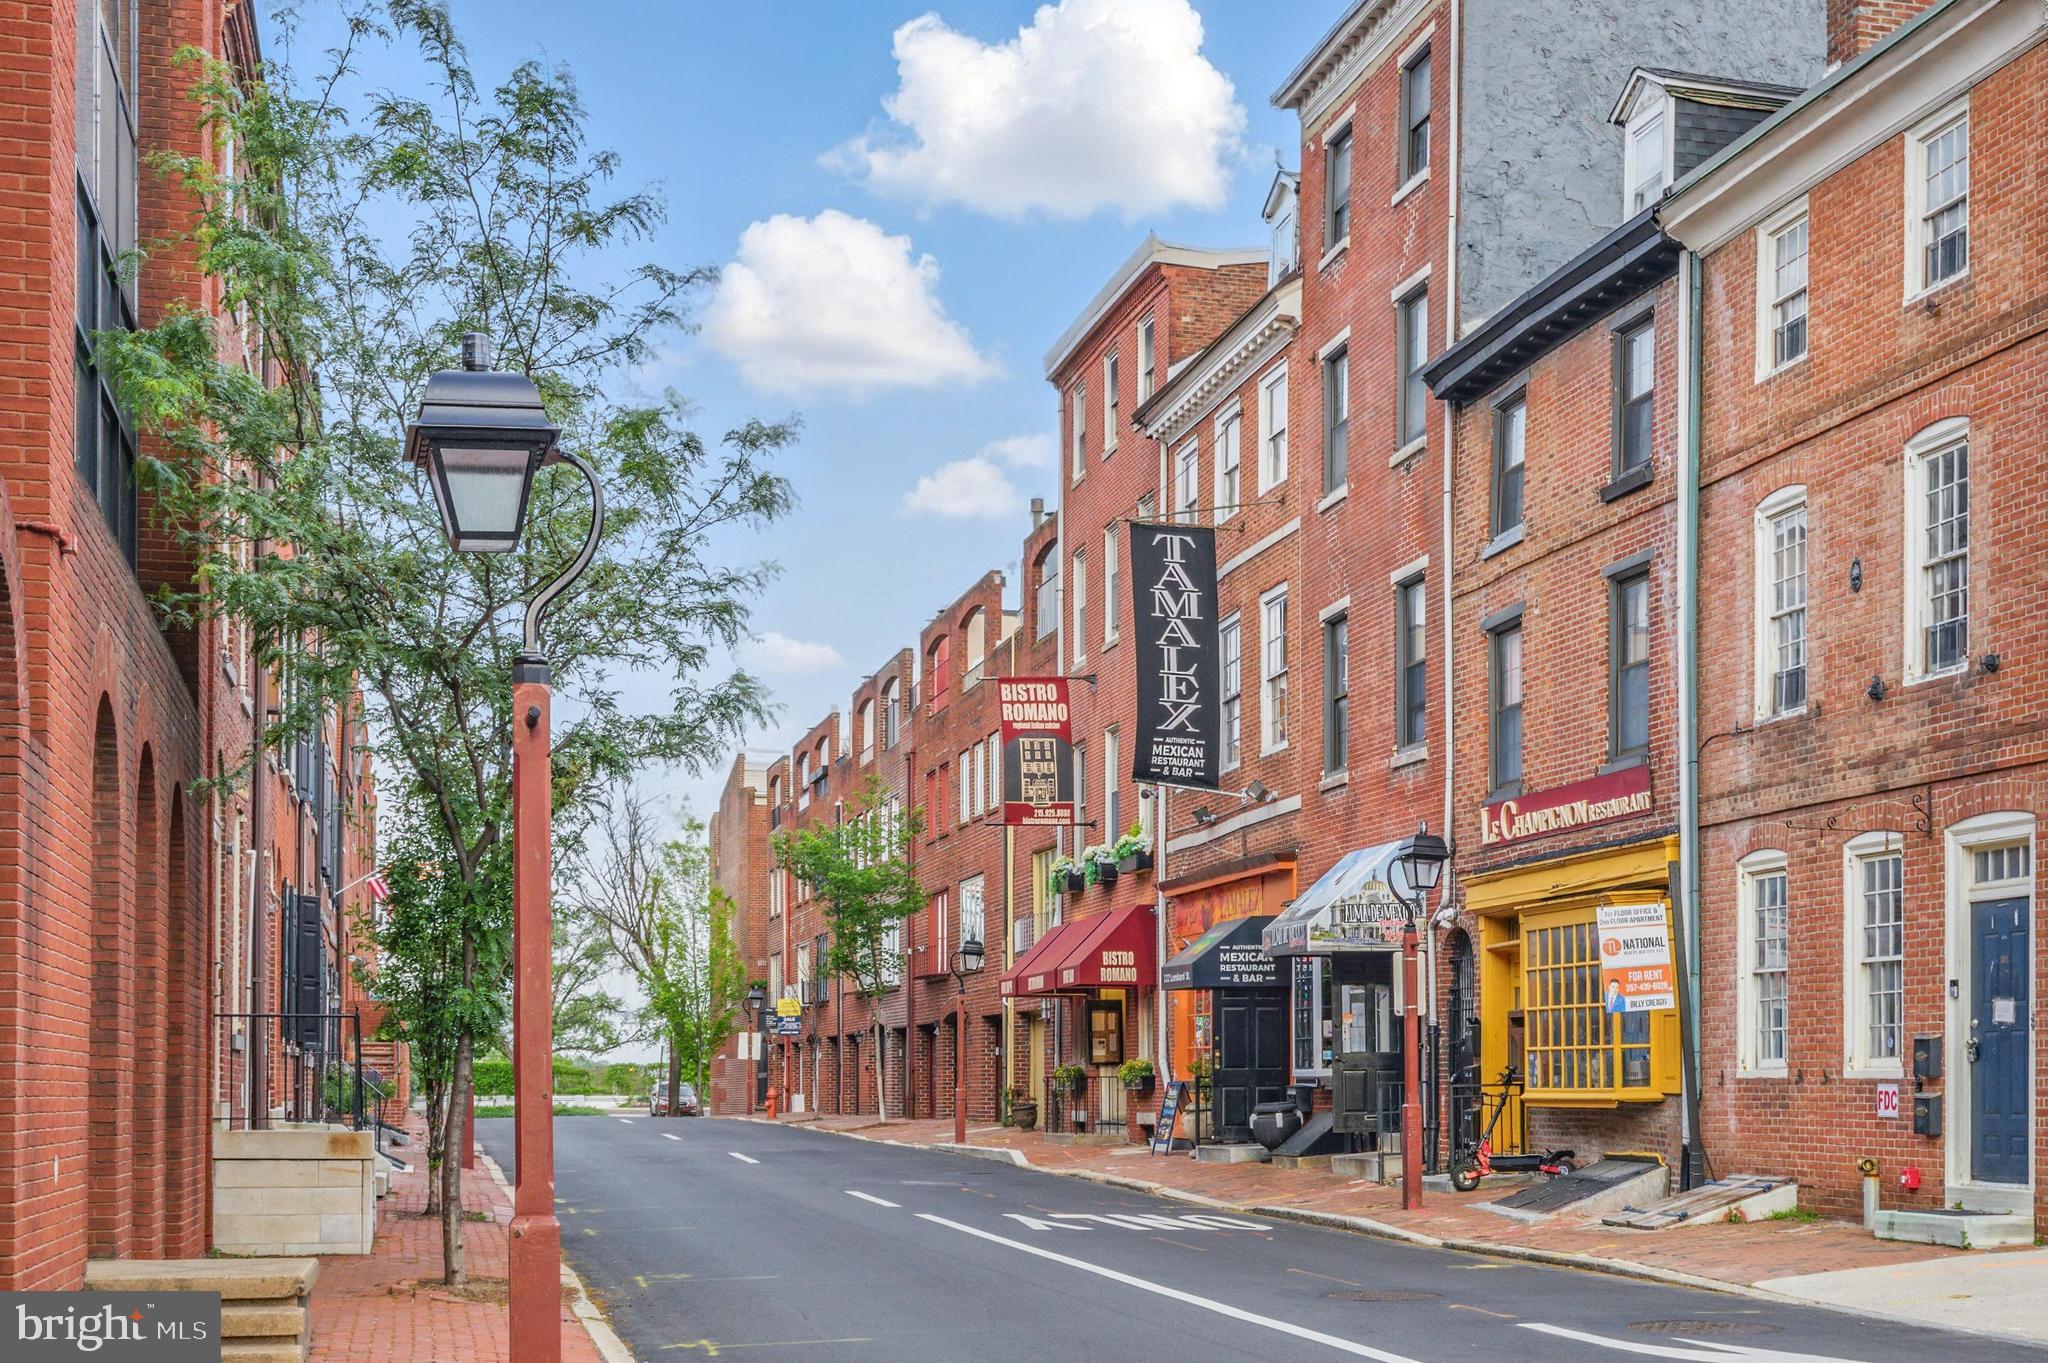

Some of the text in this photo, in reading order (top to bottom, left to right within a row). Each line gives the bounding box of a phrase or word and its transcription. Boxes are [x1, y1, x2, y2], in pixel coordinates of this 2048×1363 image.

[1150, 534, 1203, 732] TAMALEX
[1000, 683, 1057, 702] BISTRO
[1002, 703, 1068, 722] ROMANO
[1165, 737, 1195, 745] AUTHENTIC
[1152, 744, 1204, 759] MEXICAN
[1151, 756, 1205, 768] RESTAURANT
[1162, 766, 1193, 778] & BAR
[1587, 792, 1651, 822] RESTAURANT
[1344, 903, 1370, 923] ALMA
[1370, 903, 1381, 922] DE
[1614, 909, 1632, 917] FLOOR
[1630, 914, 1664, 923] APARTMENT
[1623, 936, 1666, 950] NATIONAL
[1102, 951, 1135, 966] BISTRO
[1100, 967, 1137, 982] ROMANO
[1220, 964, 1276, 972] RESTAURANT
[1628, 969, 1663, 981] FOR RENT
[1233, 974, 1264, 983] & BAR
[1630, 1000, 1645, 1008] BILLY
[1878, 1090, 1898, 1111] FDC
